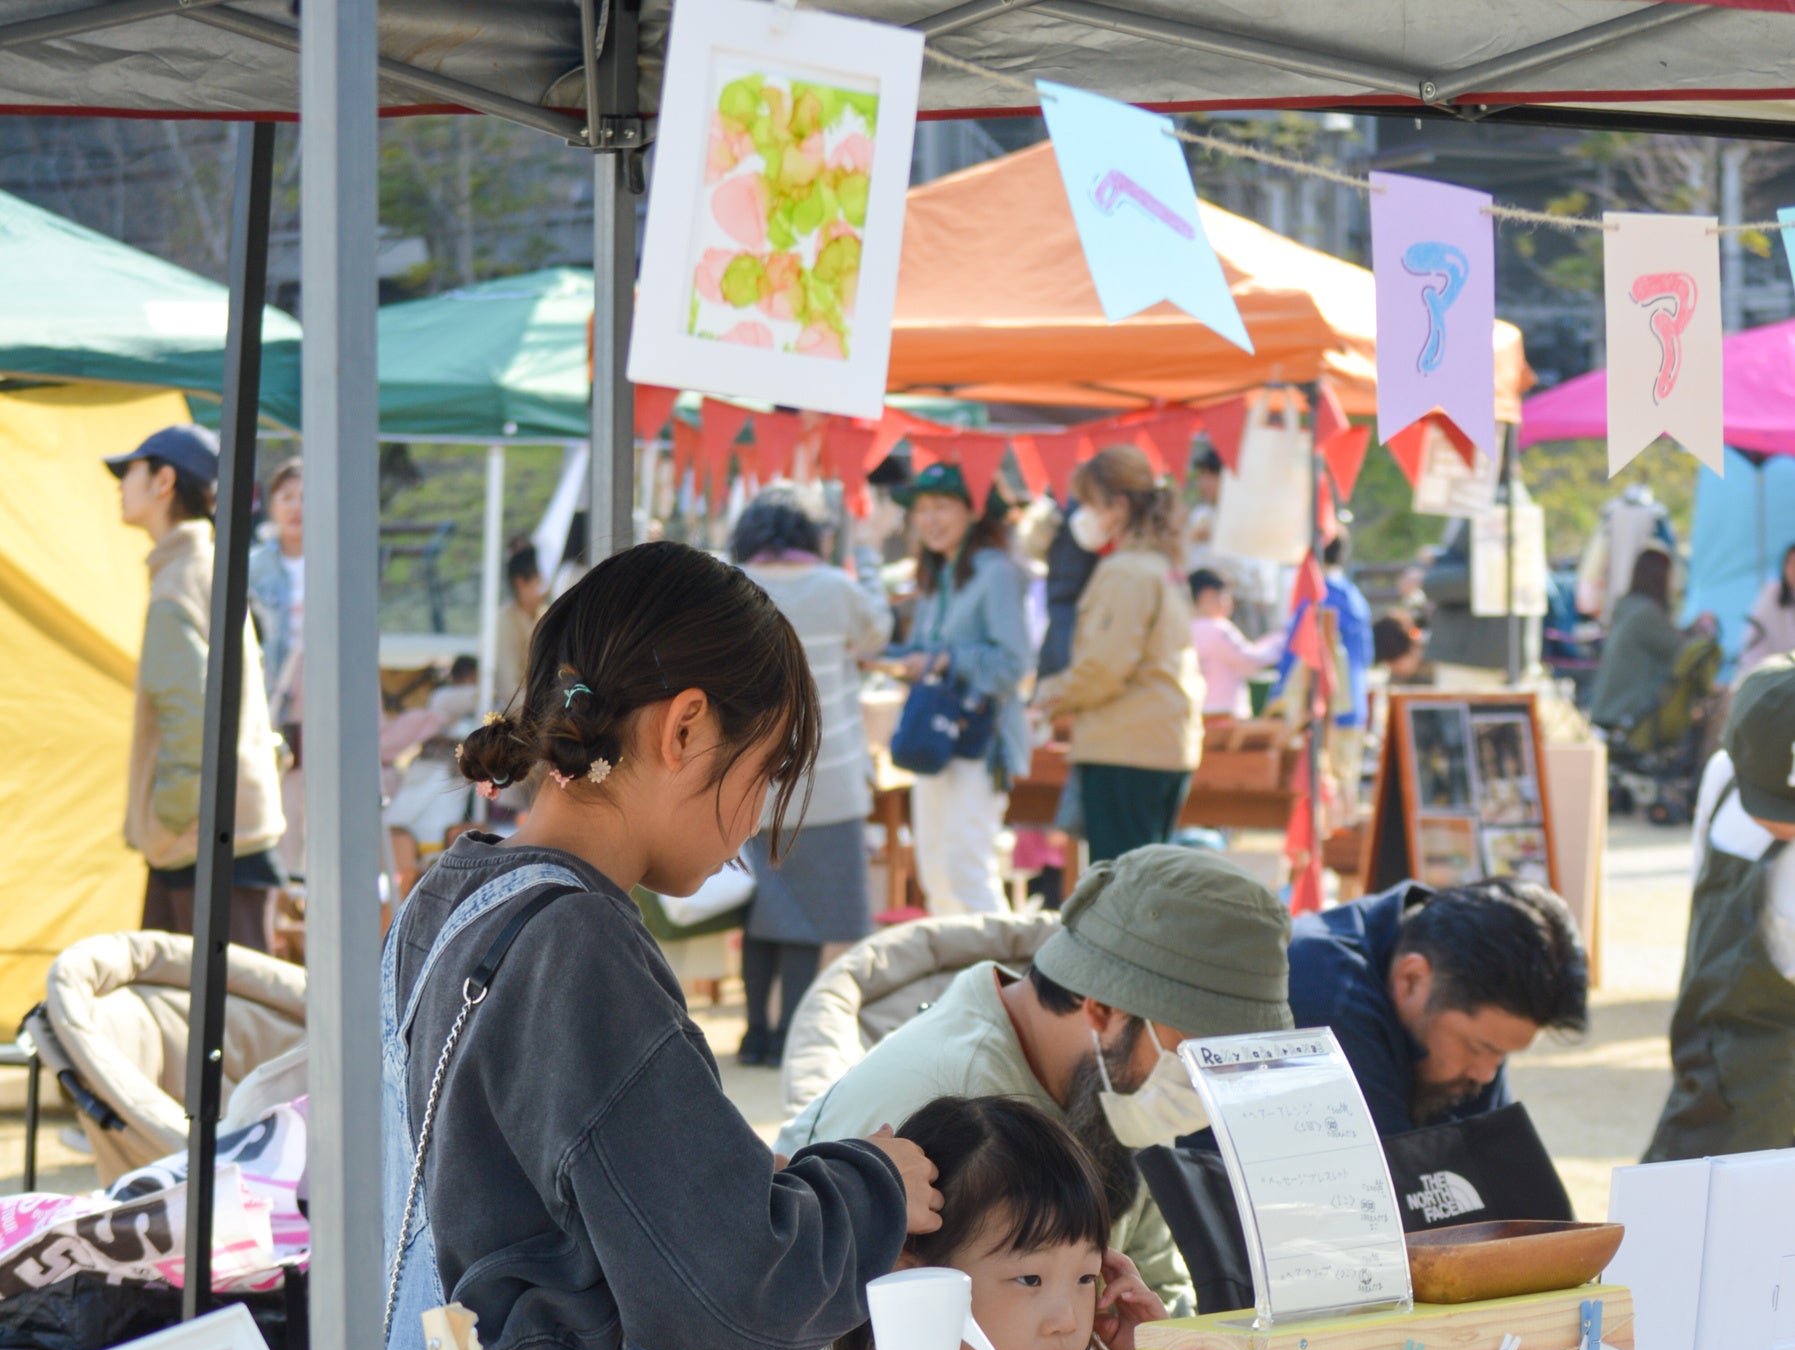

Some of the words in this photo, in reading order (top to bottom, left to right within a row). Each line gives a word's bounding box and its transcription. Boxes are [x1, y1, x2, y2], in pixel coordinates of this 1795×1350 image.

[1419, 1171, 1447, 1191] THE
[1406, 1185, 1451, 1211] NORTH
[1423, 1201, 1460, 1223] FACE
